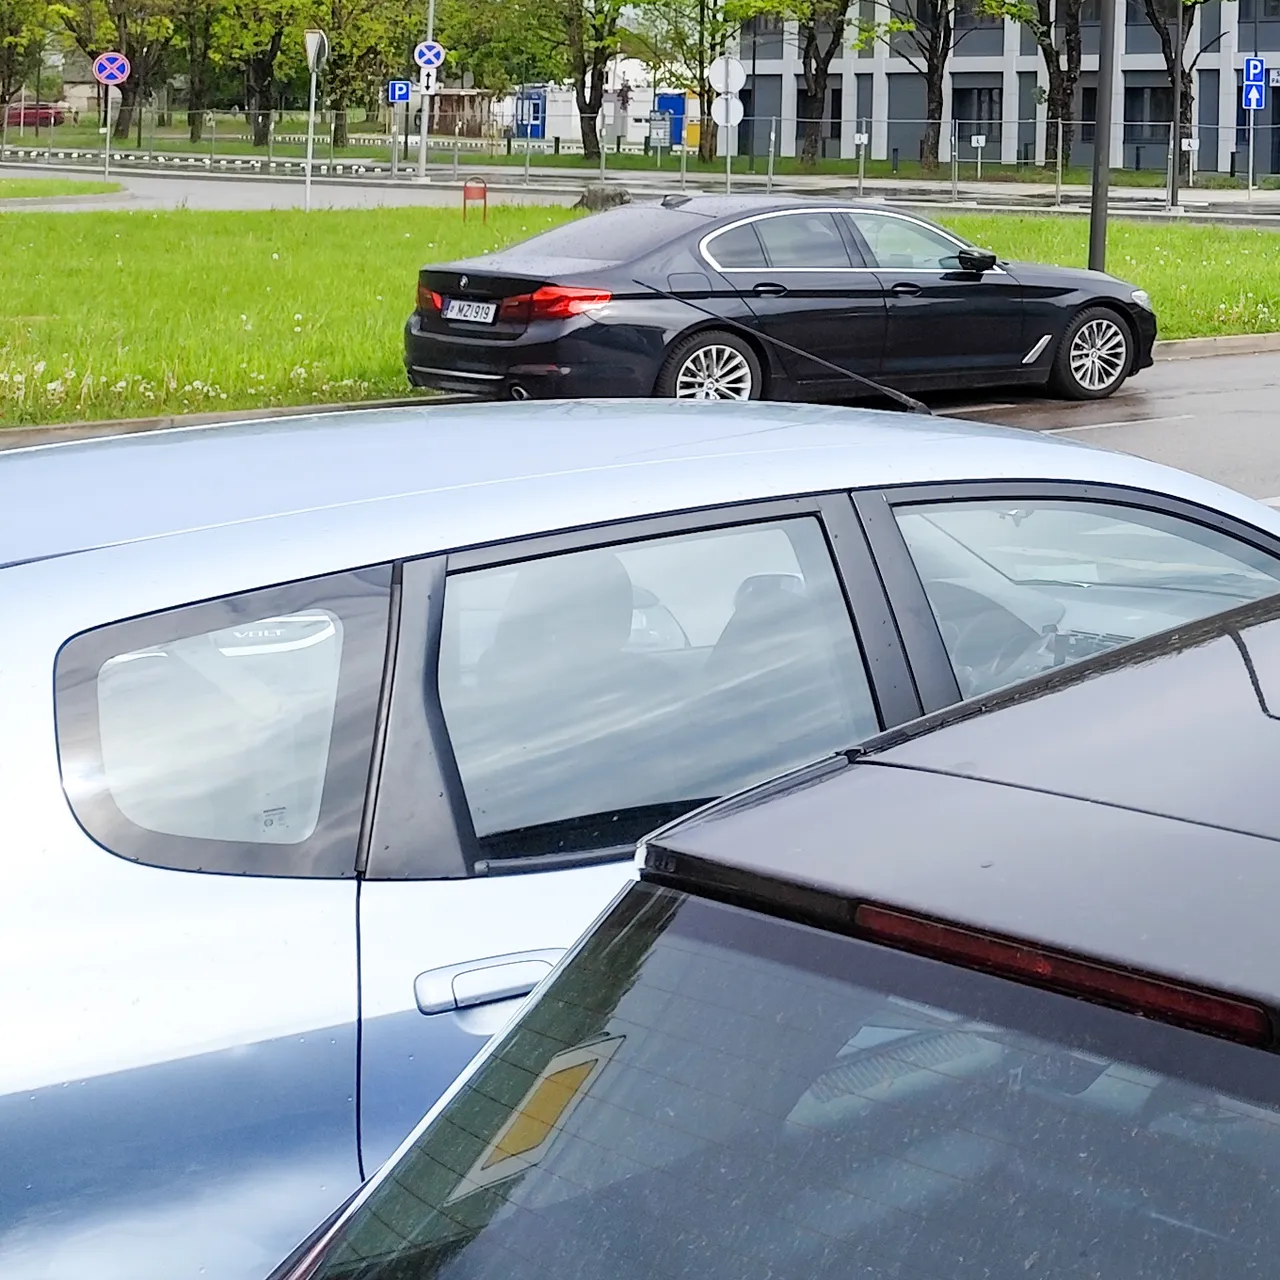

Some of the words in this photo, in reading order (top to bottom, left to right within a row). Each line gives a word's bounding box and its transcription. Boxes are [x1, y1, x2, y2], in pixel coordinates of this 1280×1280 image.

[1250, 60, 1261, 80] P
[395, 83, 407, 100] P
[456, 303, 490, 320] MZI919
